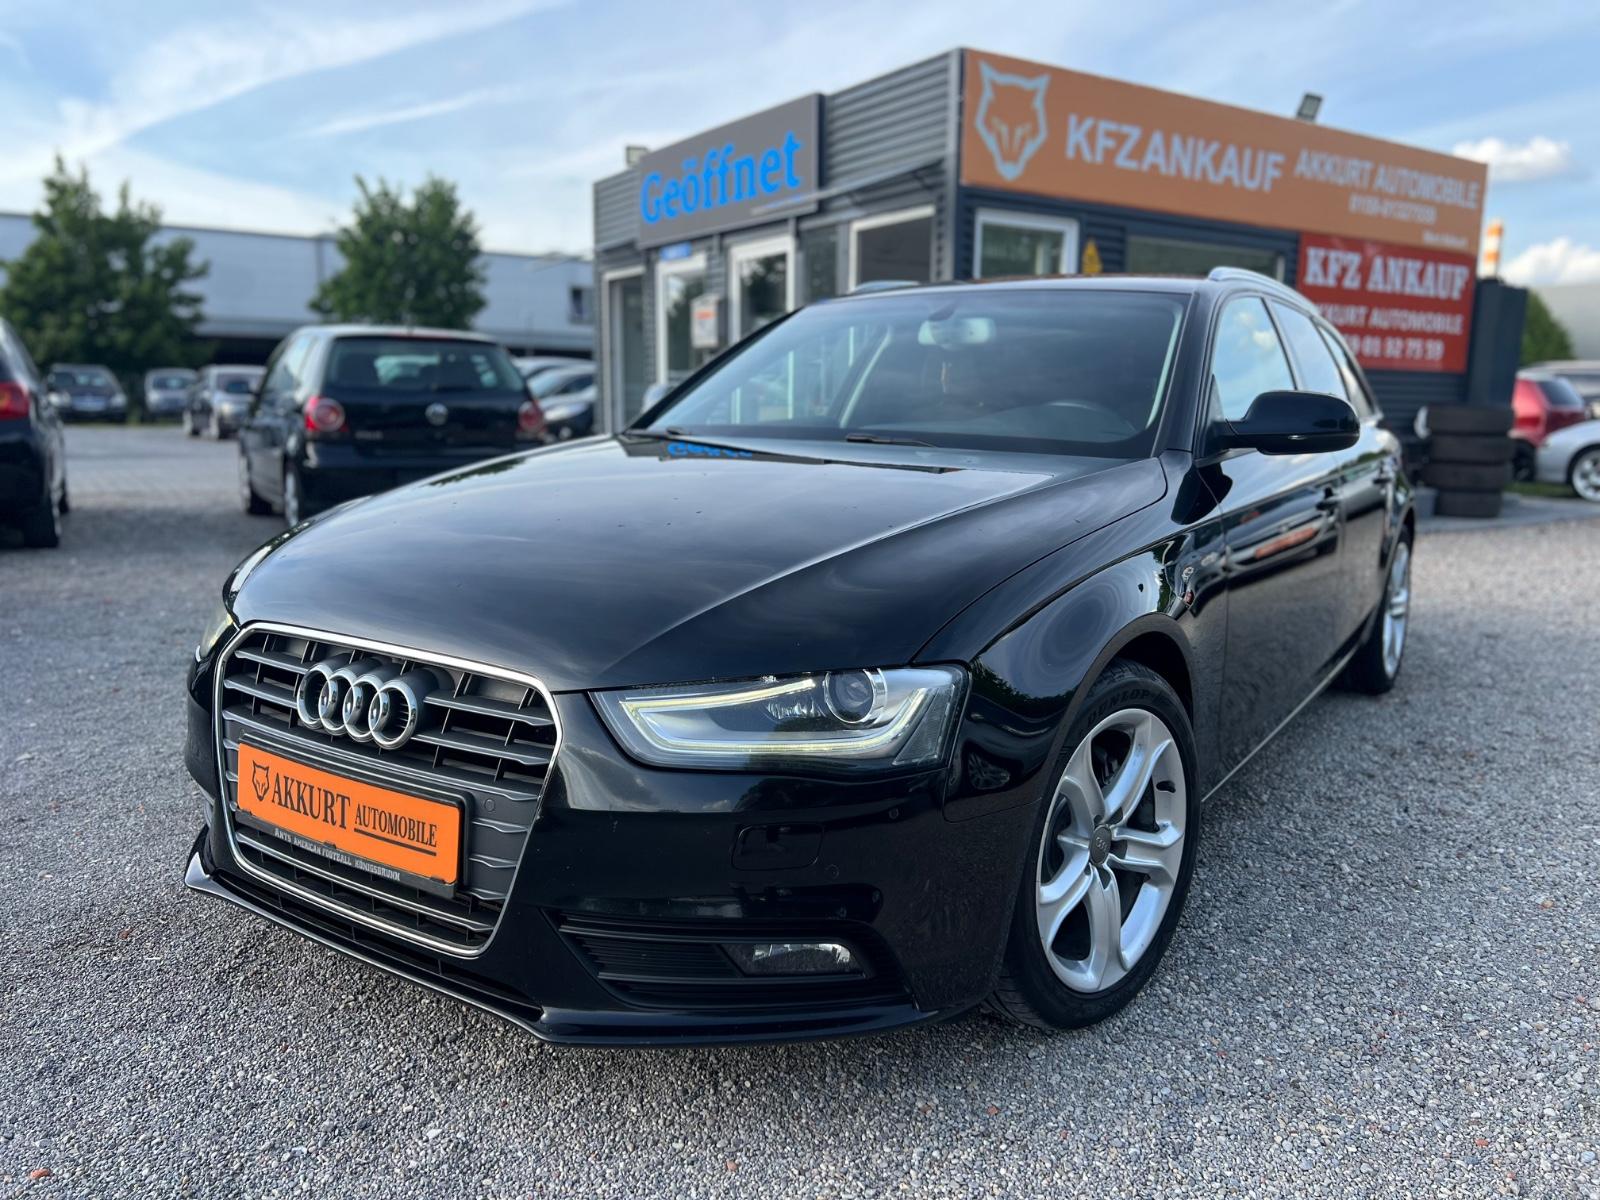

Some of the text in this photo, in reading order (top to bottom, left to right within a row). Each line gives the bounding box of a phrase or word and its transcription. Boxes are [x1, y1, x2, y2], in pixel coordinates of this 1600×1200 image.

[641, 130, 803, 224] Geöffnet
[1294, 149, 1480, 210] AKKURT AUTOMOBILE
[1304, 247, 1469, 301] KFZ ANKAUF
[1369, 308, 1463, 335] AUTOMOBILE
[1087, 688, 1150, 728] DUNLOP
[272, 773, 437, 847] AKKURT AUTOMOBILE
[293, 837, 321, 855] AMERICAN
[322, 848, 352, 866] FOOTBALL
